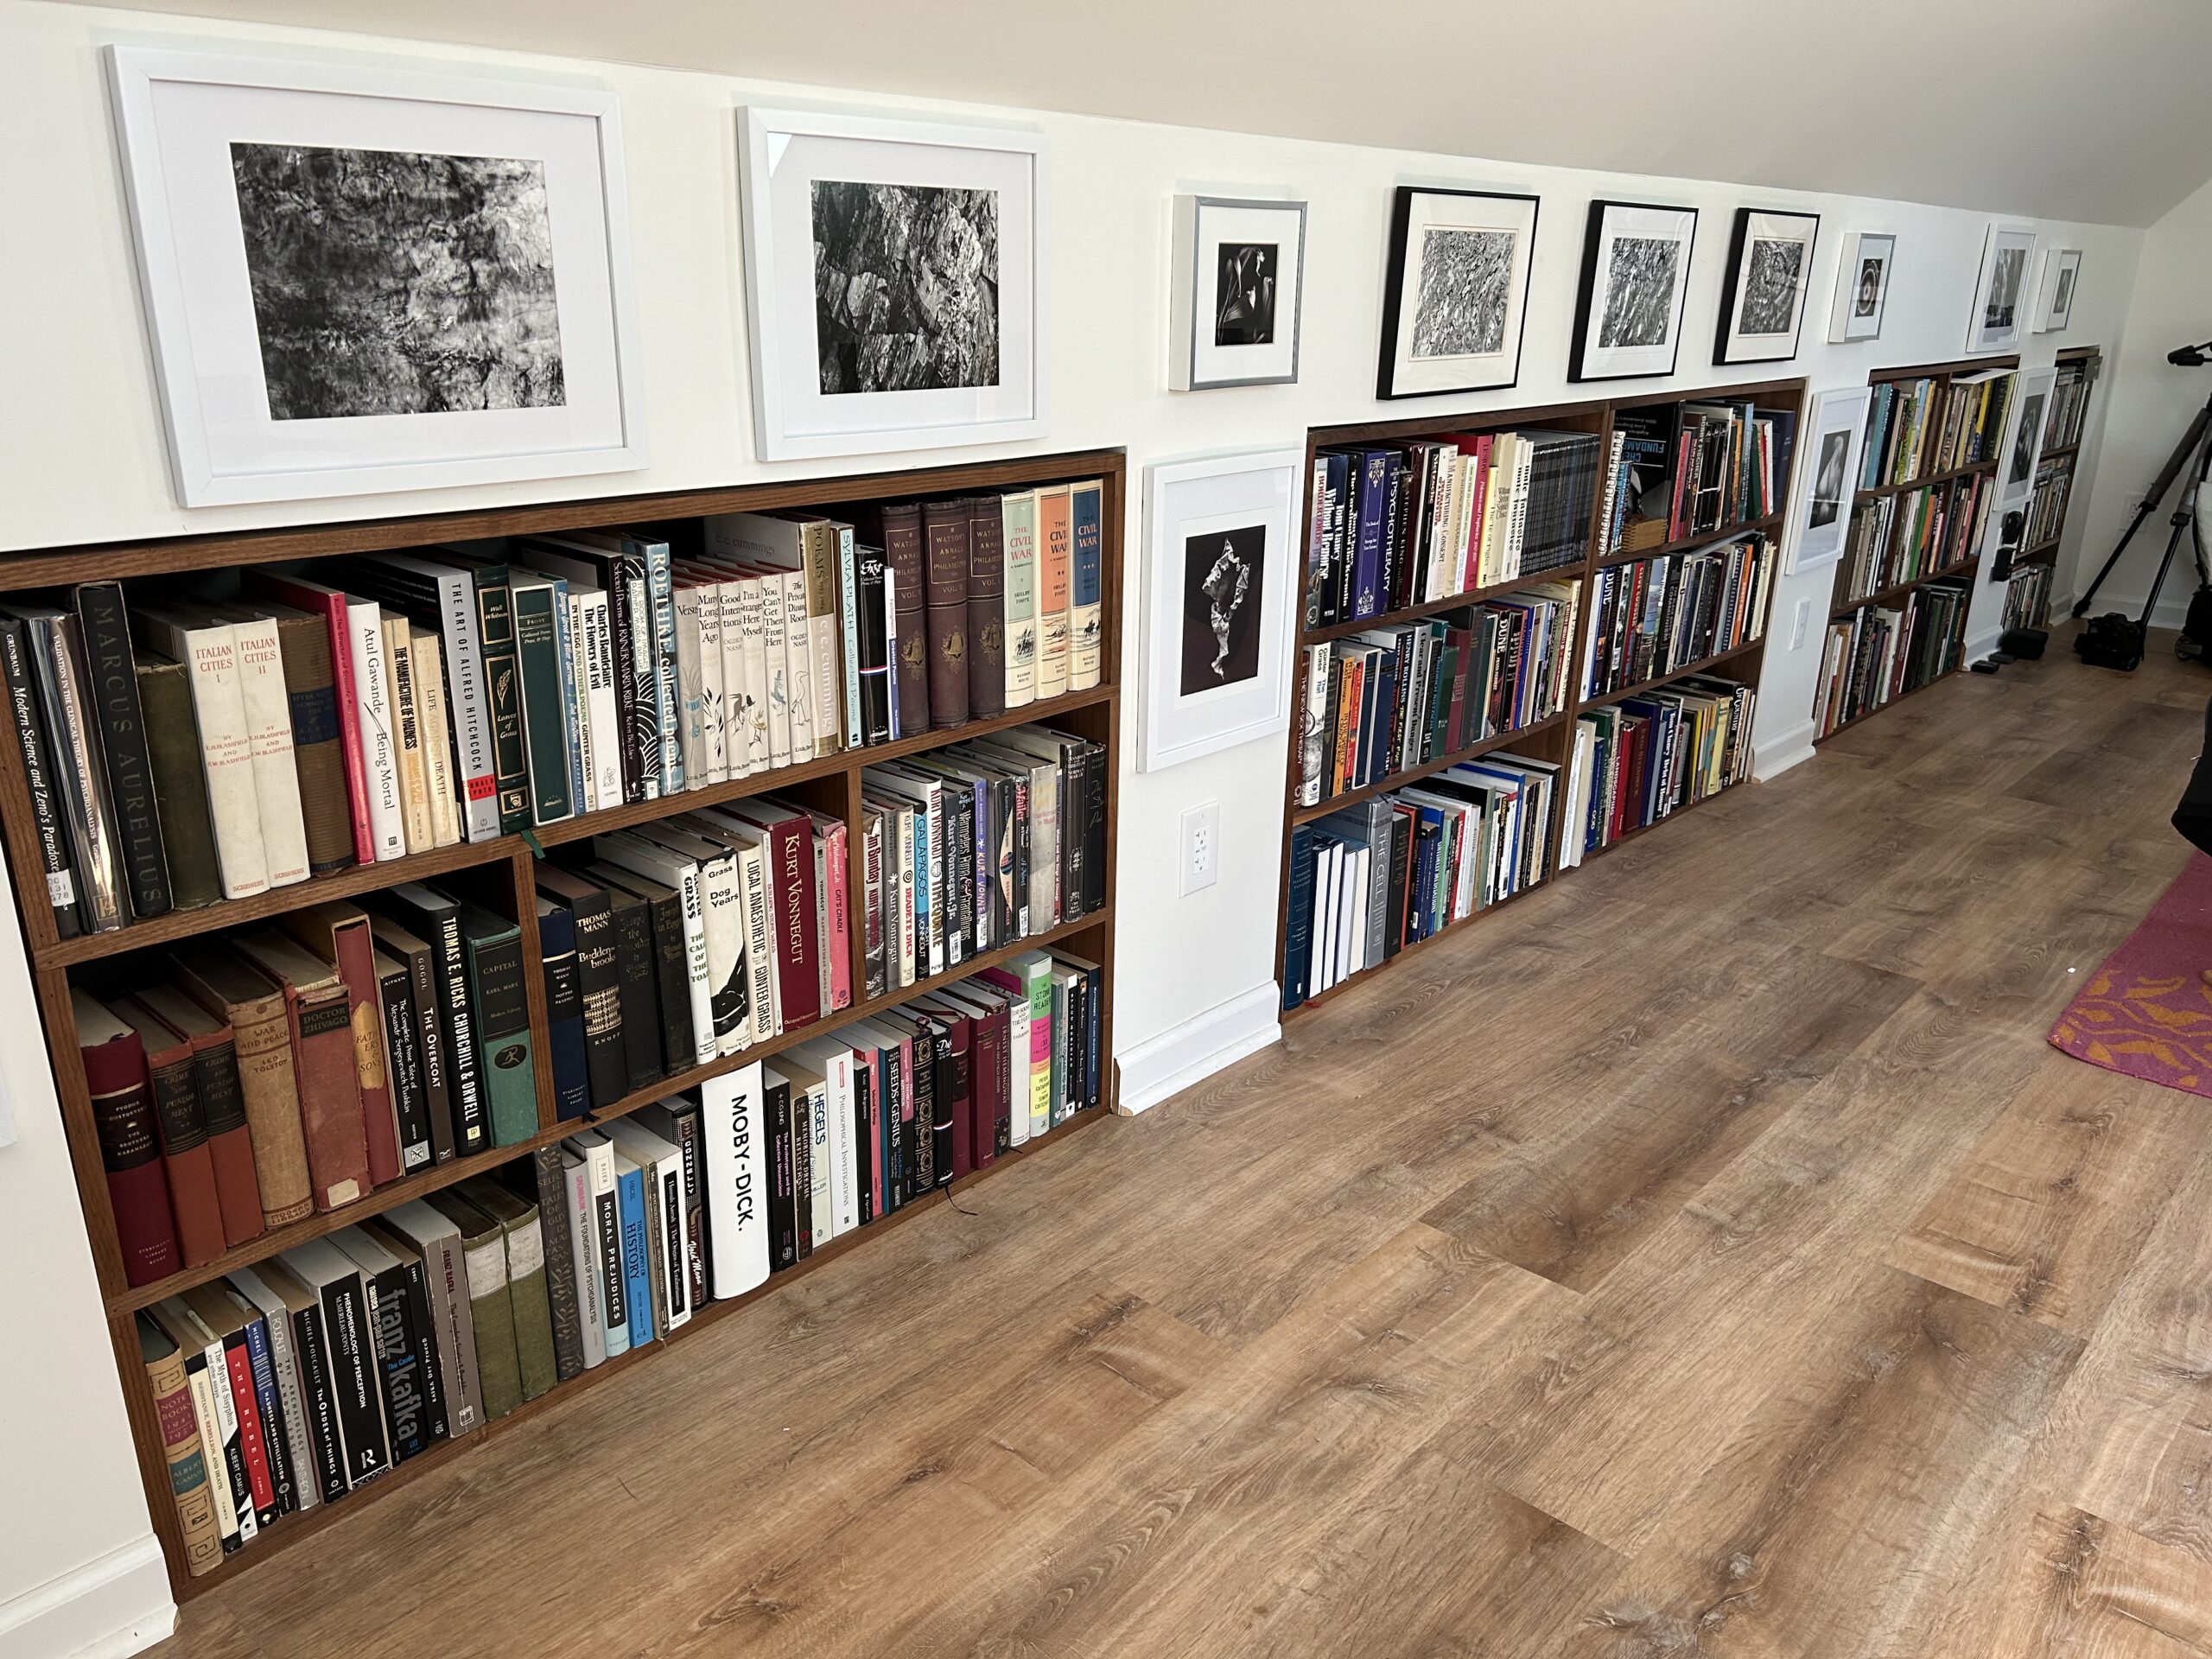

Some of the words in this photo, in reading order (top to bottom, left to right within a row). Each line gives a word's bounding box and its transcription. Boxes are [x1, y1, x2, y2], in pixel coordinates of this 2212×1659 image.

[1323, 487, 1337, 531] Without
[1441, 464, 1455, 529] MANUFACTURING
[1078, 524, 1097, 536] CIVIL
[1335, 503, 1344, 525] Tom
[814, 525, 824, 578] POEMS
[1010, 536, 1032, 547] CIVIL
[1078, 537, 1097, 548] WAR
[1331, 527, 1343, 561] Clancy
[1383, 480, 1398, 592] PSYCHOTHERAPY
[1438, 530, 1448, 563] CONSENT
[1011, 549, 1032, 561] WAR
[1319, 532, 1333, 580] Remorse
[451, 582, 462, 605] THE
[721, 594, 741, 604] Good
[743, 591, 753, 600] I'm
[764, 588, 778, 596] You
[764, 598, 781, 607] Can't
[1603, 573, 1614, 605] DUNE
[455, 611, 465, 632] ART
[585, 607, 594, 624] The
[597, 605, 607, 638] Charles
[677, 606, 698, 616] Versus
[698, 607, 718, 618] Long
[699, 621, 719, 630] Years
[723, 619, 741, 627] tions
[743, 615, 760, 624] Here
[764, 618, 783, 626] There
[842, 535, 852, 582] SYLVIA
[849, 639, 857, 686] Collected
[195, 645, 232, 659] ITALIAN
[240, 638, 276, 651] ITALIAN
[365, 627, 378, 655] Atul
[458, 639, 467, 652] OF
[586, 626, 597, 660] Flowers
[702, 632, 719, 644] Ago
[1497, 619, 1508, 653] DUNE
[200, 658, 233, 672] CITIES
[245, 651, 276, 664] CITIES
[394, 646, 407, 660] THE
[600, 639, 612, 688] Baudelaire
[368, 658, 382, 715] Gawande
[396, 660, 413, 708] MANUFACTURE
[461, 658, 474, 702] ALFRED
[590, 674, 601, 690] Evil
[661, 658, 677, 722] collected
[822, 652, 833, 733] cummings
[1400, 665, 1409, 703] ROLLINS
[13, 687, 29, 726] Modern
[22, 729, 38, 766] Science
[54, 635, 67, 677] VALIDATION
[80, 779, 97, 839] PSYCHOANALYSIS
[402, 717, 417, 749] MADNESS
[427, 690, 437, 711] LIFE
[435, 761, 446, 796] DEATH
[466, 707, 482, 770] HITCHCOCK
[1664, 730, 1674, 758] Clancy
[94, 607, 133, 735] MARCUS
[118, 753, 162, 904] AURELIUS
[376, 733, 389, 768] Being
[664, 728, 677, 772] poems
[30, 770, 45, 787] and
[380, 769, 396, 810] Mortal
[1609, 756, 1621, 816] LANDSCAPING
[35, 791, 50, 823] Zeno's
[785, 833, 800, 878] KURT
[1377, 830, 1386, 861] THE
[709, 866, 733, 879] Grass
[747, 859, 761, 891] LOCAL
[1376, 864, 1384, 899] CELL
[683, 876, 696, 919] GRASS
[709, 887, 731, 900] Dog
[711, 893, 739, 909] Years
[889, 888, 898, 914] Kurt
[576, 910, 611, 927] THOMAS
[584, 919, 608, 933] MANN
[749, 891, 766, 954] ANAESTHETIC
[786, 878, 803, 964] VONNEGUT
[931, 880, 944, 948] TIMEQUAKE
[442, 917, 460, 962] THOMAS
[578, 946, 615, 963] Budden-
[887, 915, 898, 964] Vonnegut
[418, 957, 428, 990] GOGOL
[448, 964, 462, 976] E.
[483, 961, 518, 976] CAPITAL
[590, 953, 616, 968] brooks
[384, 976, 406, 987] AITKEN
[449, 976, 467, 1008] RICKS
[254, 1026, 276, 1037] WAR
[303, 1007, 346, 1024] DOCTOR
[304, 1016, 347, 1033] ZHIVAGO
[401, 1012, 410, 1043] Complete
[423, 1007, 433, 1031] THE
[756, 1002, 771, 1034] GRASS
[454, 1013, 473, 1071] CHURCHILL
[594, 1032, 620, 1046] KNOPF
[254, 1058, 287, 1073] TOLSTOY
[359, 1060, 381, 1071] SONS
[390, 1003, 399, 1037] Alexandr
[400, 1085, 410, 1114] Pushkin
[427, 1033, 441, 1088] OVERCOAT
[890, 1062, 899, 1099] SEEDS
[461, 1081, 479, 1122] ORWELL
[814, 1093, 826, 1146] HEGEL'S
[891, 1103, 900, 1147] GENIUS
[841, 1150, 849, 1206] INVESTIGATIONS
[604, 1201, 613, 1243] MORAL
[626, 1223, 639, 1280] HISTORY
[369, 1285, 378, 1311] nausea
[587, 1274, 598, 1324] PSYCHOANALYSIS
[608, 1249, 620, 1320] PREJUDICES
[303, 1311, 314, 1342] MICHEL
[378, 1288, 407, 1360] franz
[308, 1344, 321, 1383] FOUCAULT
[344, 1292, 359, 1356] PHENOMENOLOGY
[354, 1366, 366, 1408] PERCEPTION
[216, 1362, 226, 1383] Myth
[223, 1392, 233, 1426] Sisyphus
[389, 1362, 423, 1440] kafka
[234, 1361, 246, 1395] THE
[244, 1409, 259, 1465] REBEL
[319, 1402, 330, 1433] ORDER
[264, 1392, 275, 1422] MADNESS
[272, 1436, 285, 1480] CIVILIZATION
[230, 1448, 238, 1471] ALBERT
[234, 1471, 245, 1497] CAMUS
[326, 1443, 336, 1475] THINGS
